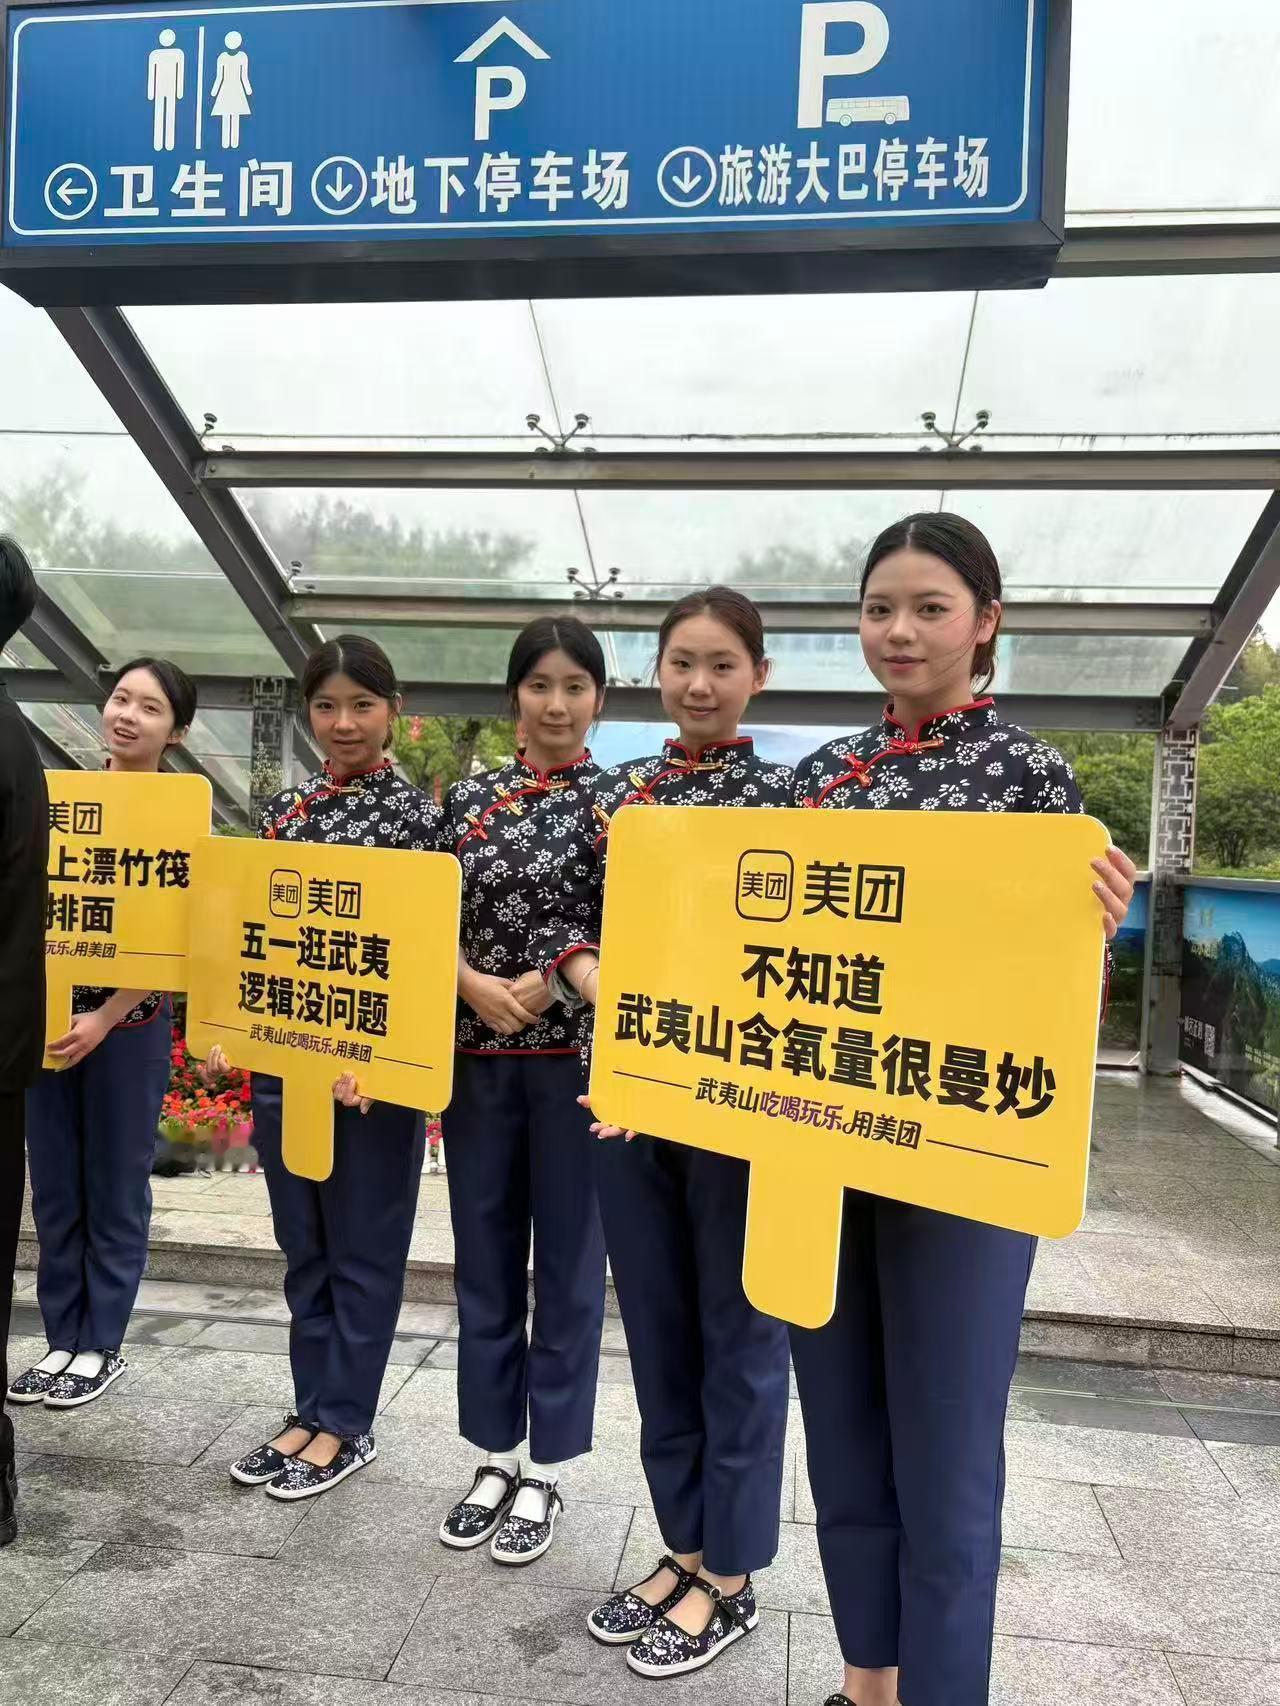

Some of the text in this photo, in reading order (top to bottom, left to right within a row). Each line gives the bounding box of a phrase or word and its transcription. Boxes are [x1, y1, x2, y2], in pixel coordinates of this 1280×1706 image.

[474, 65, 527, 141] P
[103, 158, 293, 217] 卫生间
[371, 149, 629, 215] 地下停车场
[718, 135, 991, 207] 旅游大巴停车场
[48, 845, 191, 889] 上漂竹筏
[272, 877, 362, 920] 美团 美团
[740, 860, 906, 923] 美团 美团
[240, 921, 391, 981] 五一逛武夷
[741, 944, 885, 1015] 不知道
[238, 971, 389, 1037] 逻辑没问题
[614, 992, 1057, 1120] 武夷山含氧量很曼妙
